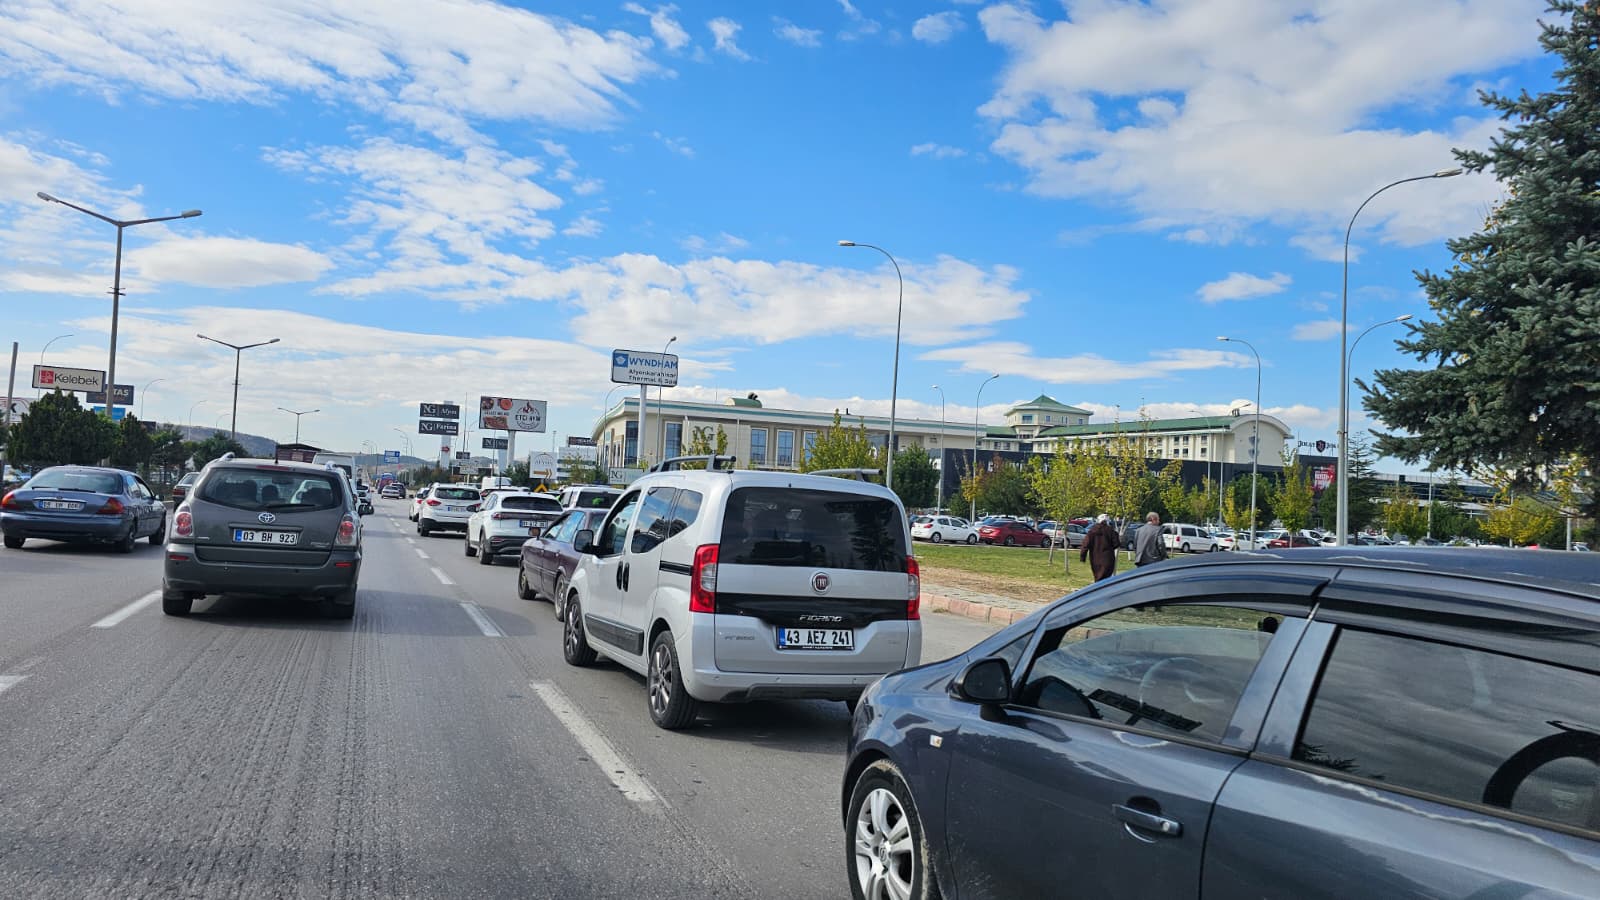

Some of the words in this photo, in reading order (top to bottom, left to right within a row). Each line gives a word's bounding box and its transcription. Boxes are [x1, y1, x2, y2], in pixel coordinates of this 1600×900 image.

[629, 357, 677, 368] WYNDHAM
[54, 373, 99, 386] Kelebek
[629, 375, 656, 383] Thermal
[423, 404, 436, 414] NG
[420, 422, 433, 431] NG
[611, 471, 623, 480] NG
[243, 532, 255, 542] 03
[261, 533, 273, 543] BH
[280, 534, 296, 544] 923
[800, 614, 842, 622] FIORINO
[787, 630, 800, 644] 43
[807, 630, 826, 645] AEZ
[831, 631, 850, 646] 241
